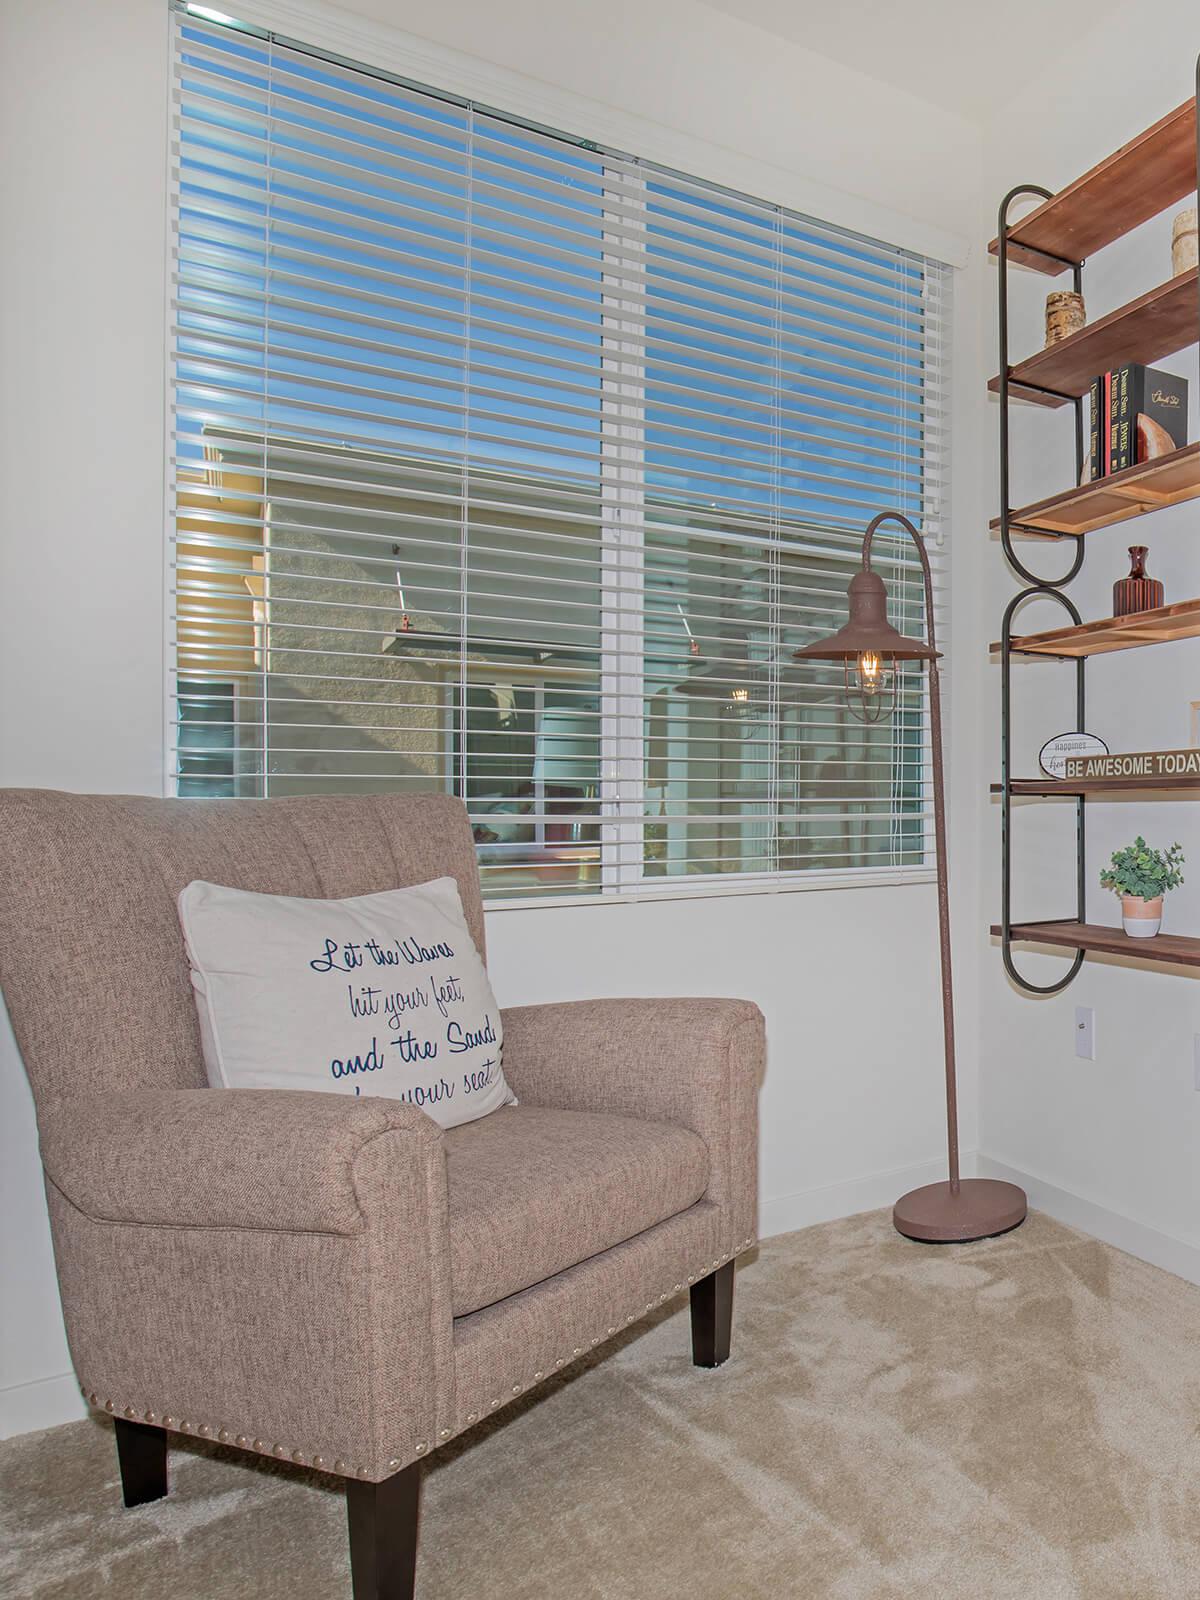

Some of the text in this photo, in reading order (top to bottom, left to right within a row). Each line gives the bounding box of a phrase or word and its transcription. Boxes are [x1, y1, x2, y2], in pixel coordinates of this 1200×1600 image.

[1067, 761, 1084, 778] BE
[1085, 756, 1153, 777] AWESOME
[310, 936, 455, 972] Let the Waves
[348, 984, 382, 1017] hit
[384, 987, 429, 1030] your
[332, 1014, 497, 1079] and the Sand
